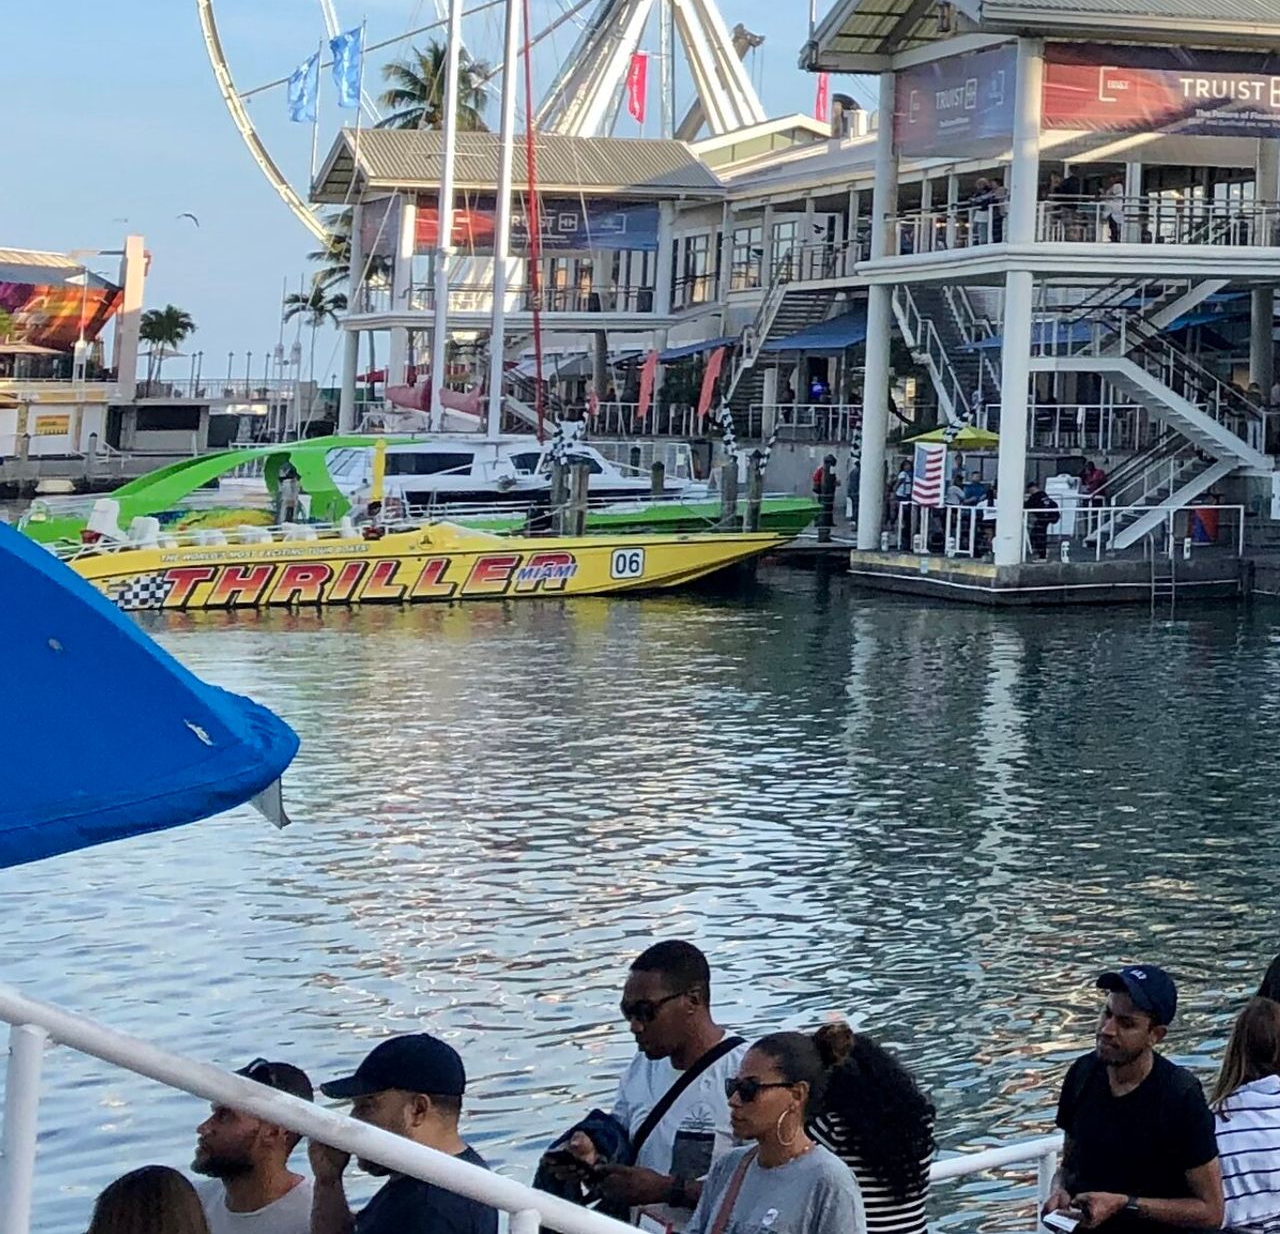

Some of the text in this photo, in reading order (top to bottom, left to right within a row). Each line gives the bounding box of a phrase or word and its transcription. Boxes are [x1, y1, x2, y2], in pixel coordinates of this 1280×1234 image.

[936, 87, 965, 109] TRUIST
[1180, 78, 1265, 100] TRUIST
[516, 565, 578, 583] MIAMI
[615, 553, 640, 574] 06
[163, 552, 576, 607] THRILLER
